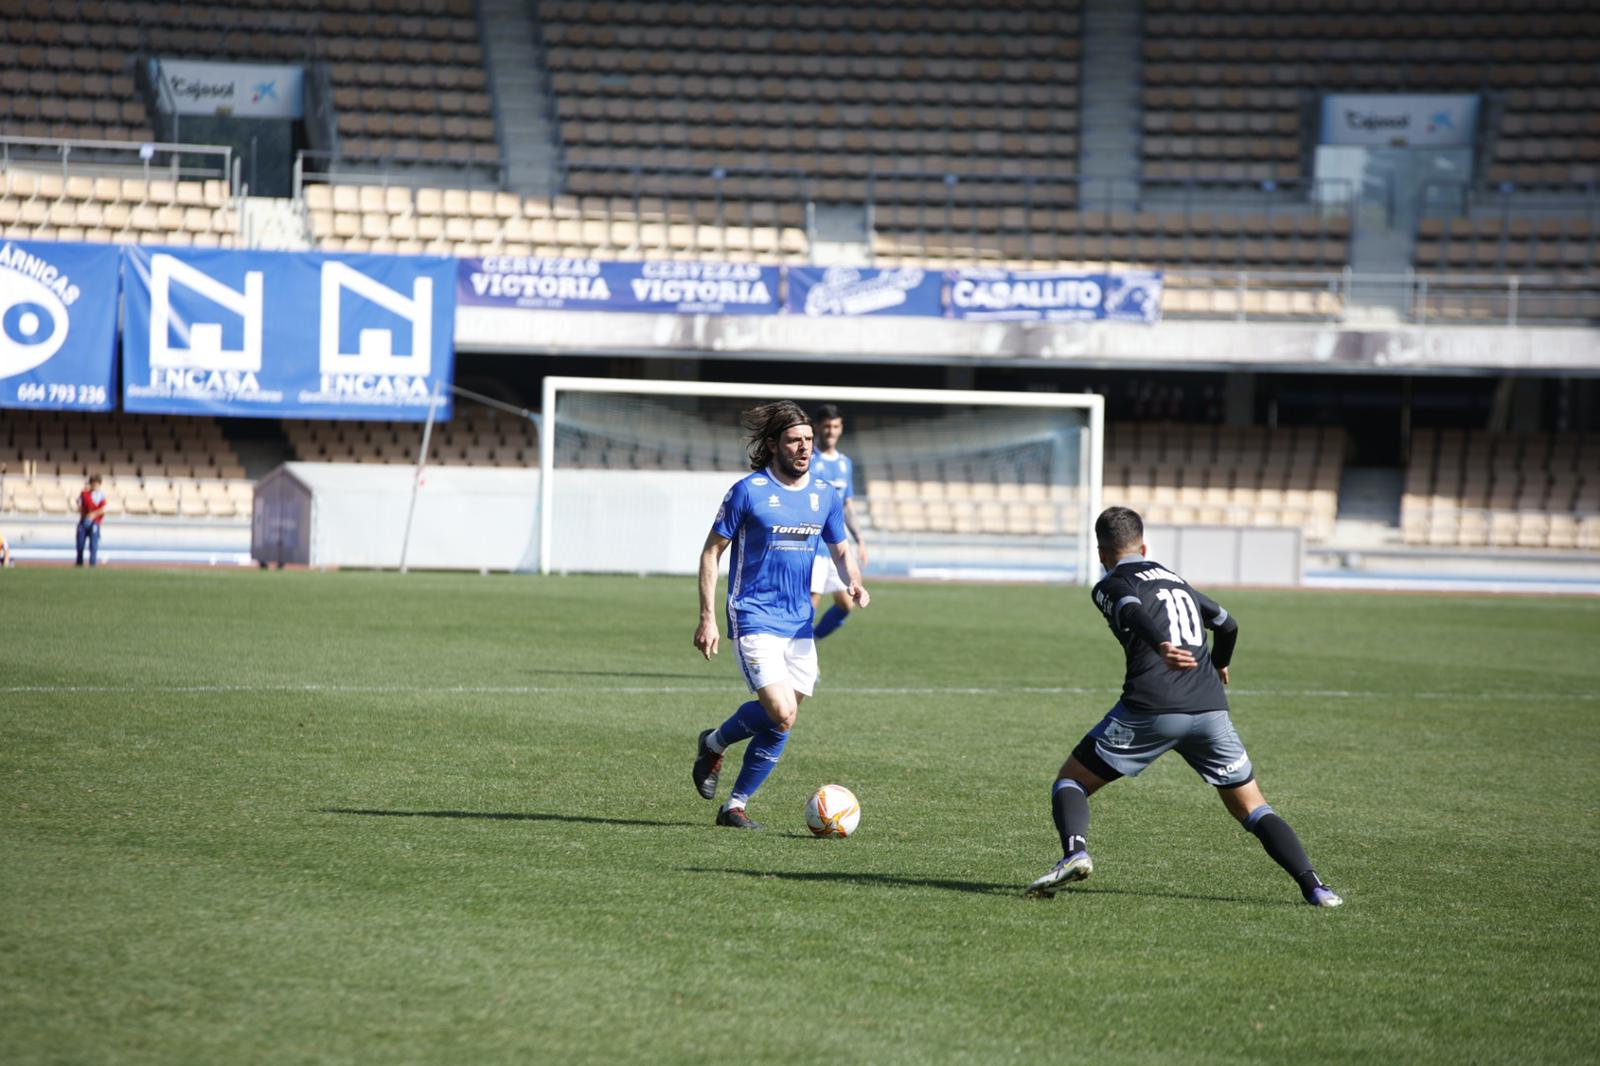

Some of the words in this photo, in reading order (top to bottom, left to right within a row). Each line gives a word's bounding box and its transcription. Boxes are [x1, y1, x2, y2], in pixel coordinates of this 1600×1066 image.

[482, 256, 600, 278] CERVEZAS
[642, 261, 761, 280] CERVEZAS
[471, 273, 611, 300] VICTORIA
[631, 278, 771, 304] VICTORIA
[953, 280, 1102, 309] CABALLITO
[151, 369, 260, 393] ENCASA
[321, 375, 428, 397] ENCASA
[1156, 588, 1203, 647] 10
